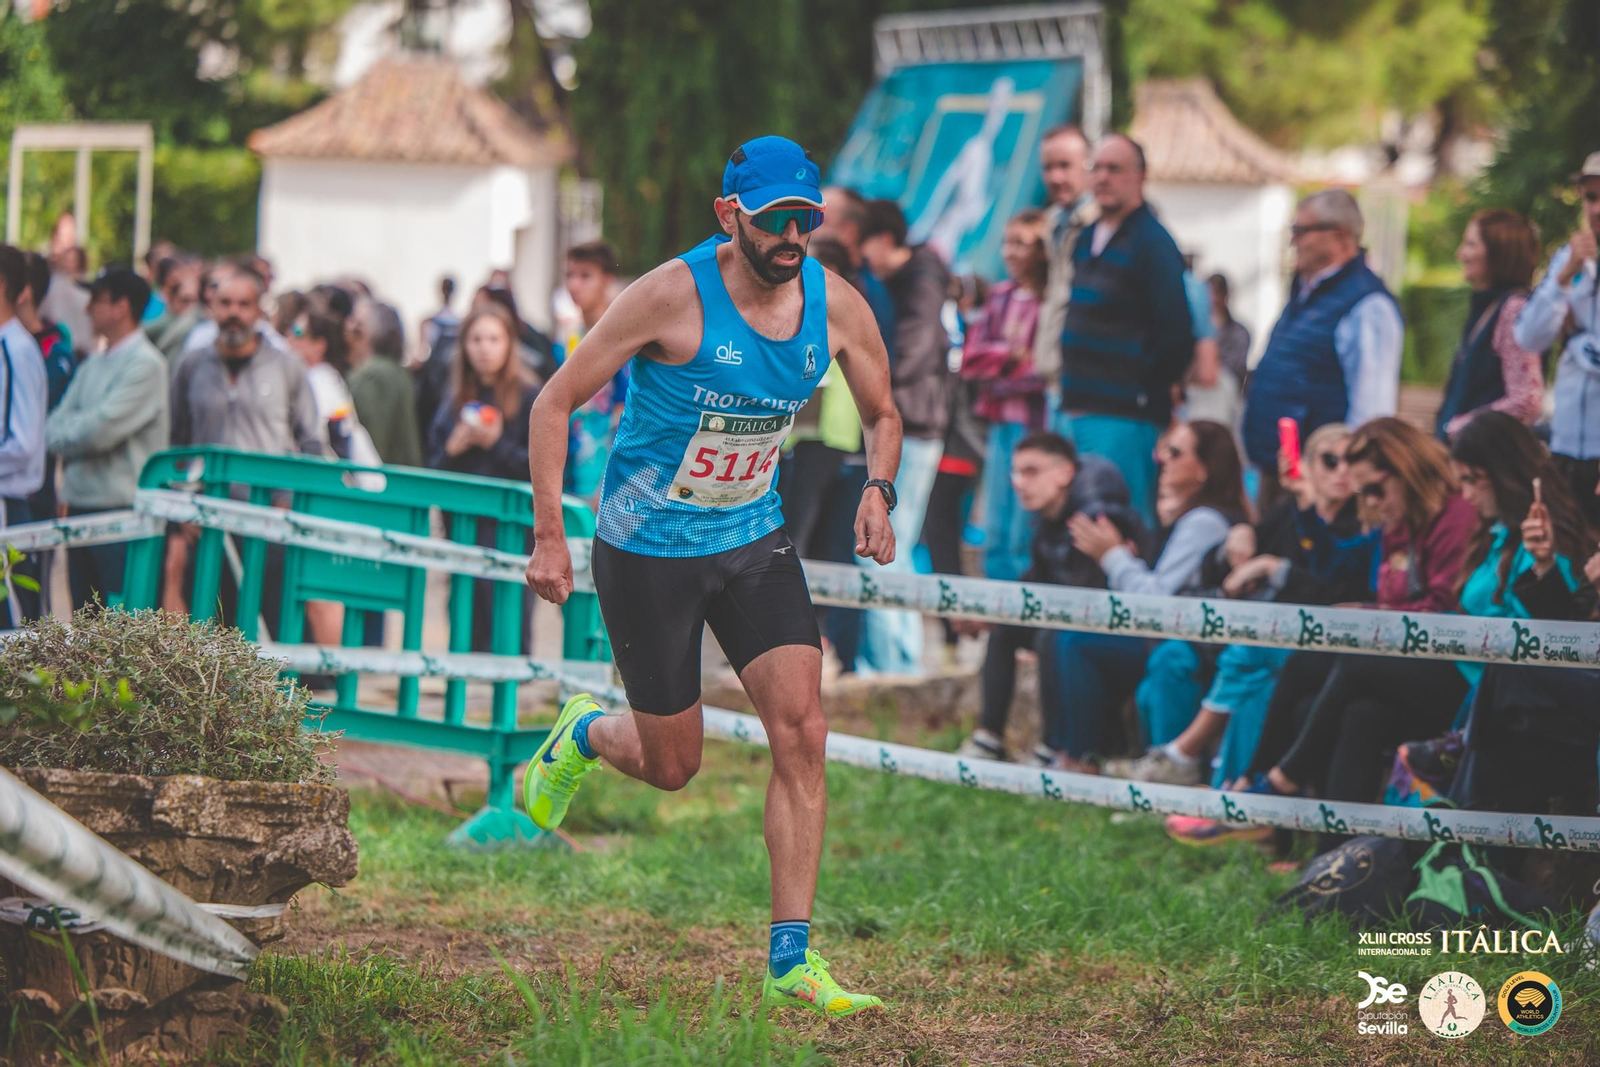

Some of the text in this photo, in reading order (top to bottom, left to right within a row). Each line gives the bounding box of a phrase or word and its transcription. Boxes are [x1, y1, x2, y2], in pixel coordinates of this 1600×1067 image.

[714, 341, 743, 366] als
[731, 419, 777, 432] ITÁLICA
[689, 445, 778, 482] 5114
[1431, 638, 1466, 655] Sevilla
[1543, 645, 1581, 662] Sevilla
[1569, 829, 1600, 841] Diputació
